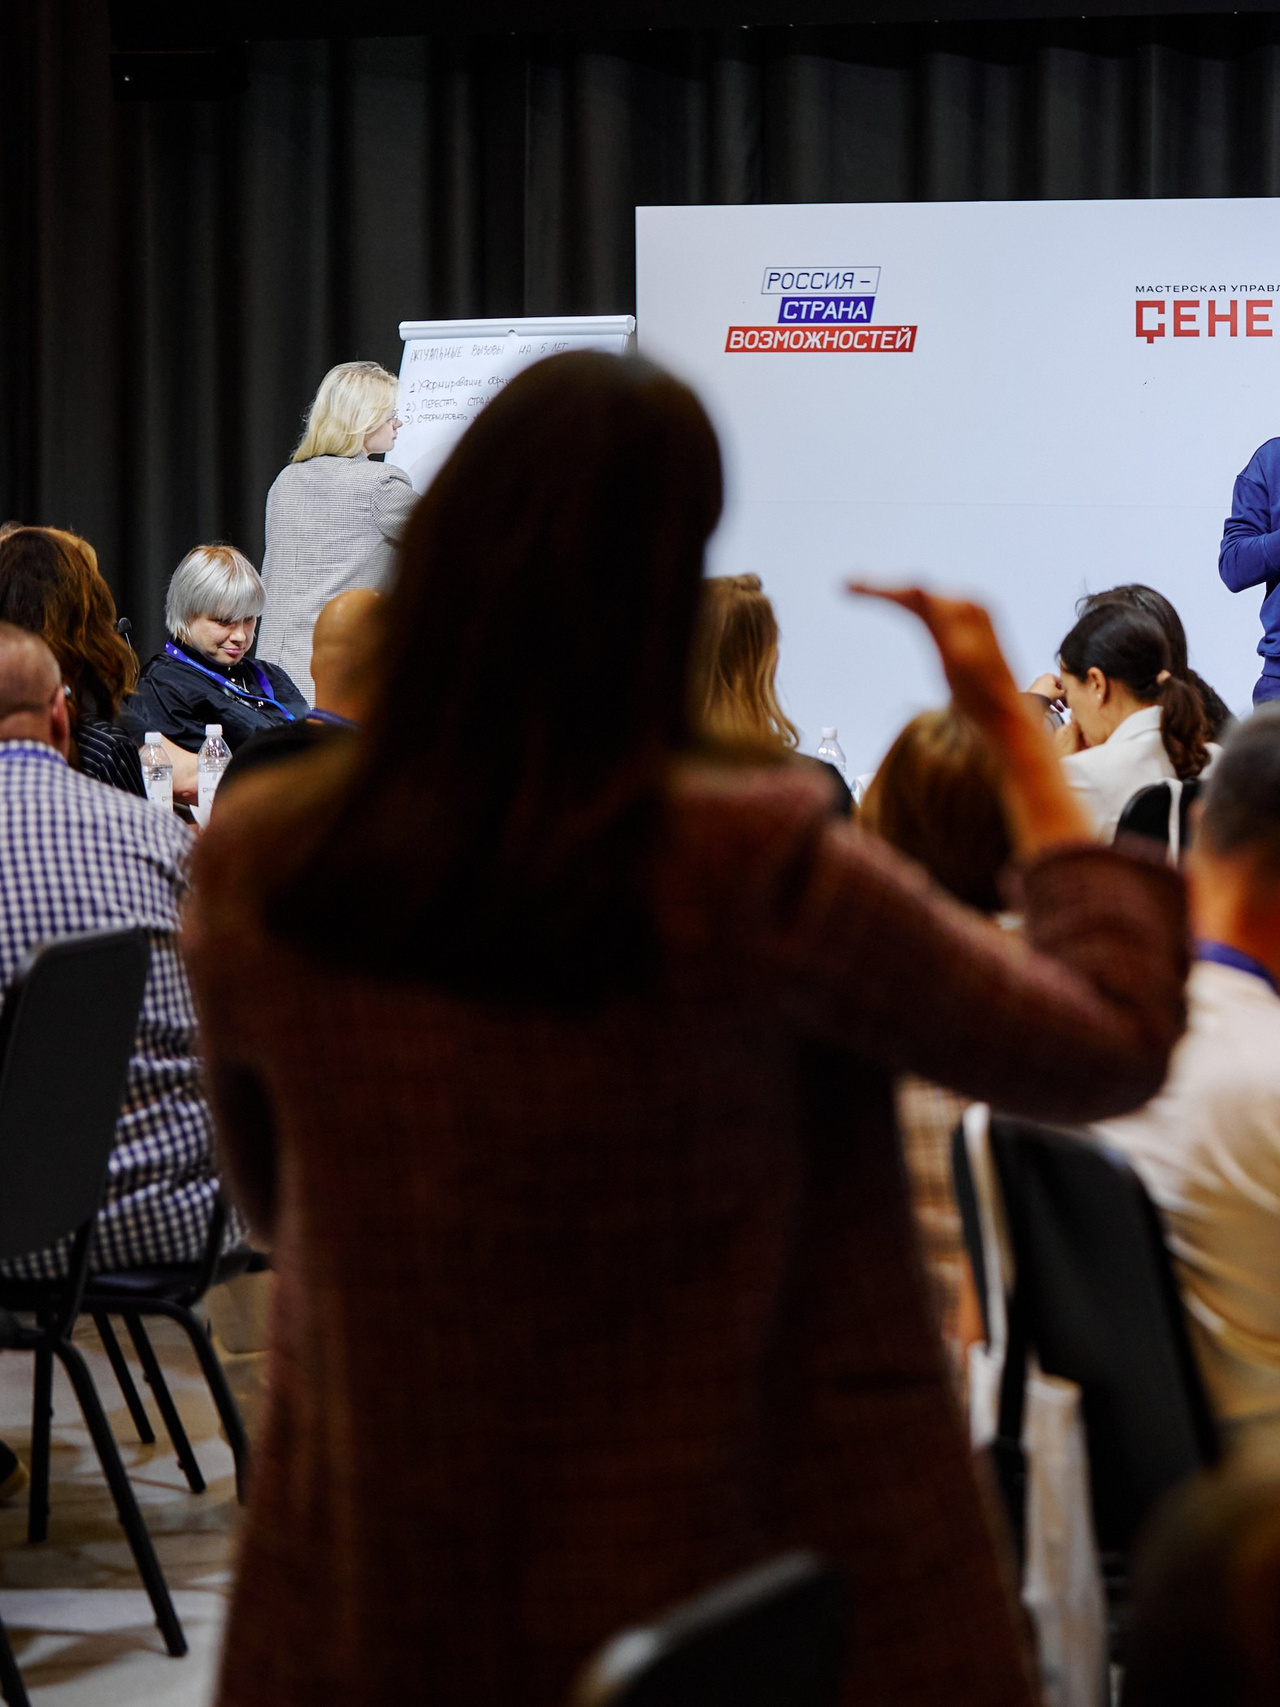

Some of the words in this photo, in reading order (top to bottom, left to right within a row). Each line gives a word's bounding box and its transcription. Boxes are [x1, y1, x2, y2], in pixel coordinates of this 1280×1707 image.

[766, 271, 855, 290] РОССИЯ
[1135, 284, 1227, 293] МАСТЕРСКАЯ
[782, 300, 868, 320] СТРАНА
[729, 327, 912, 350] ВОЗМОЖНОСТЕЙ
[540, 342, 548, 353] 5
[406, 402, 416, 412] 2)
[404, 414, 414, 425] 3)
